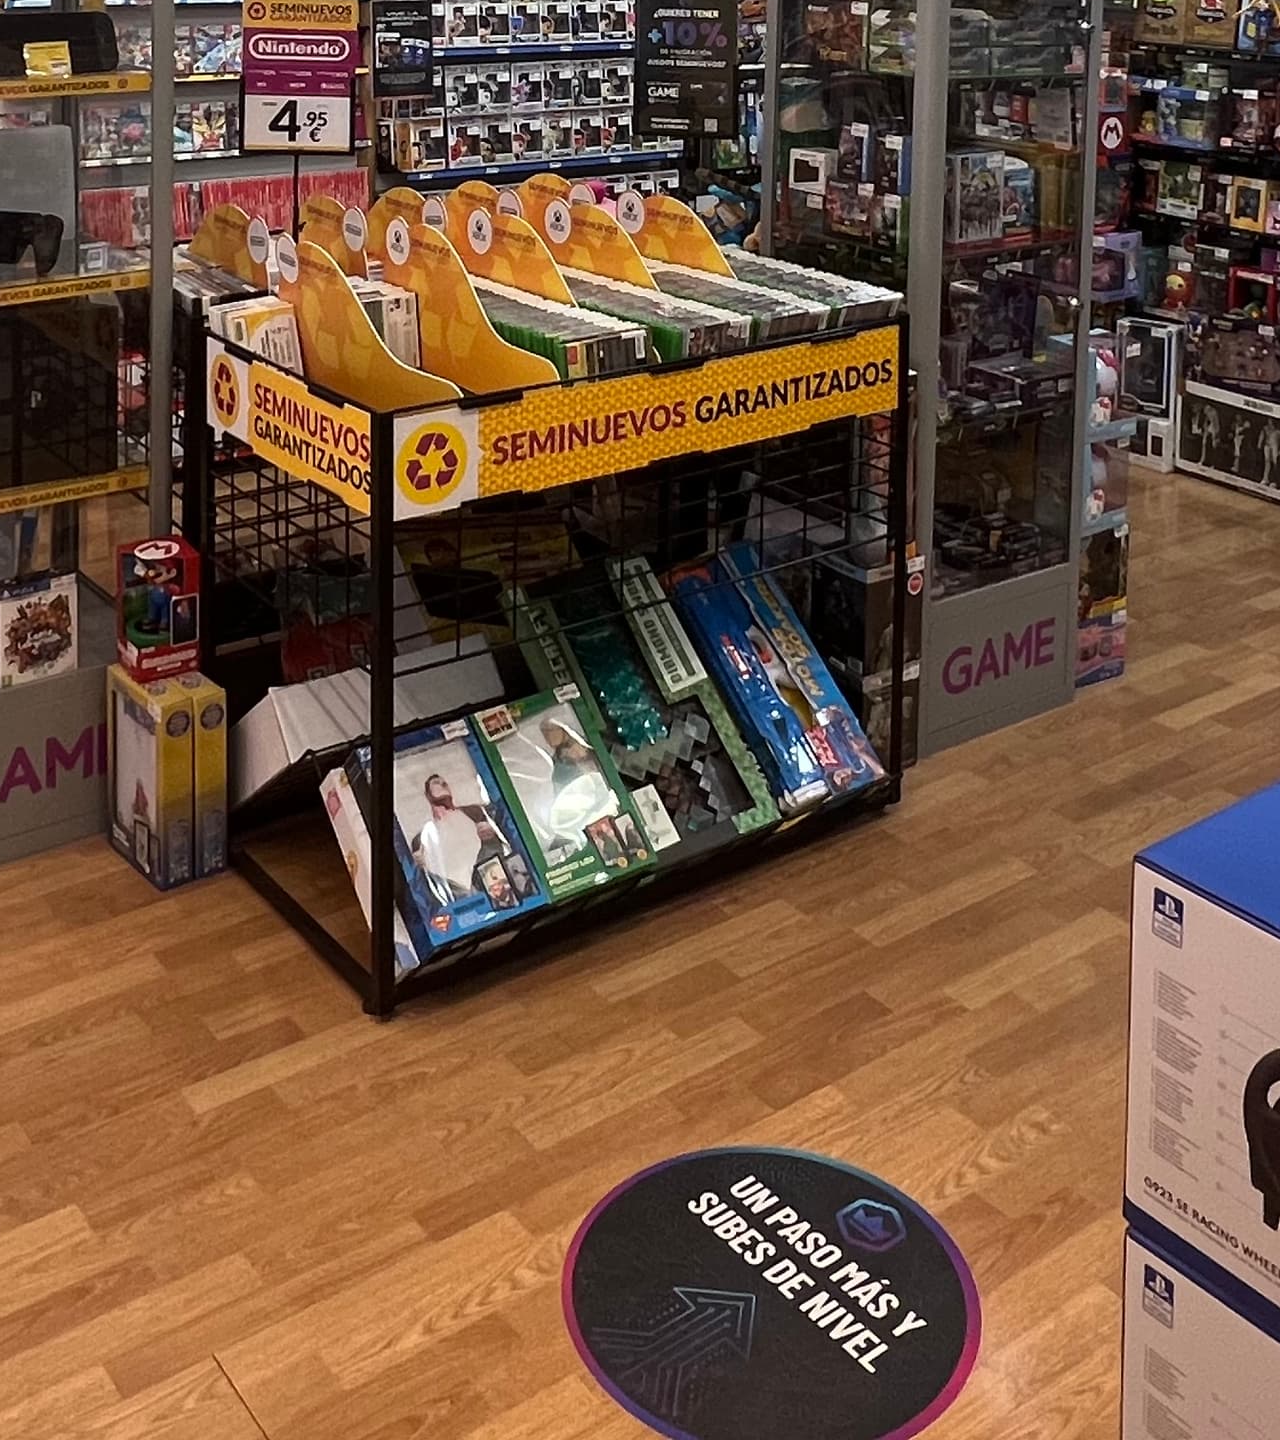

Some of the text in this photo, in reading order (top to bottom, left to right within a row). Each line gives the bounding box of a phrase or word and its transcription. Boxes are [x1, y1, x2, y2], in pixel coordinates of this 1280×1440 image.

[258, 39, 341, 56] Nintendo
[270, 2, 352, 16] SEMINUEVOS
[29, 81, 110, 93] GARANTIZADOS
[648, 86, 680, 98] GAME
[254, 382, 370, 461] SEMINUEVOS
[492, 359, 893, 466] SEMINUEVOS GARANTIZADOS
[254, 413, 370, 494] GARANTIZADOS
[942, 616, 1056, 695] GAME
[1143, 1176, 1174, 1204] G923
[1176, 1197, 1190, 1215] SE
[1191, 1209, 1239, 1250] RACING
[687, 1191, 890, 1374] SUBES DE NIVEL
[730, 1175, 927, 1338] UN PASO MÁS Y
